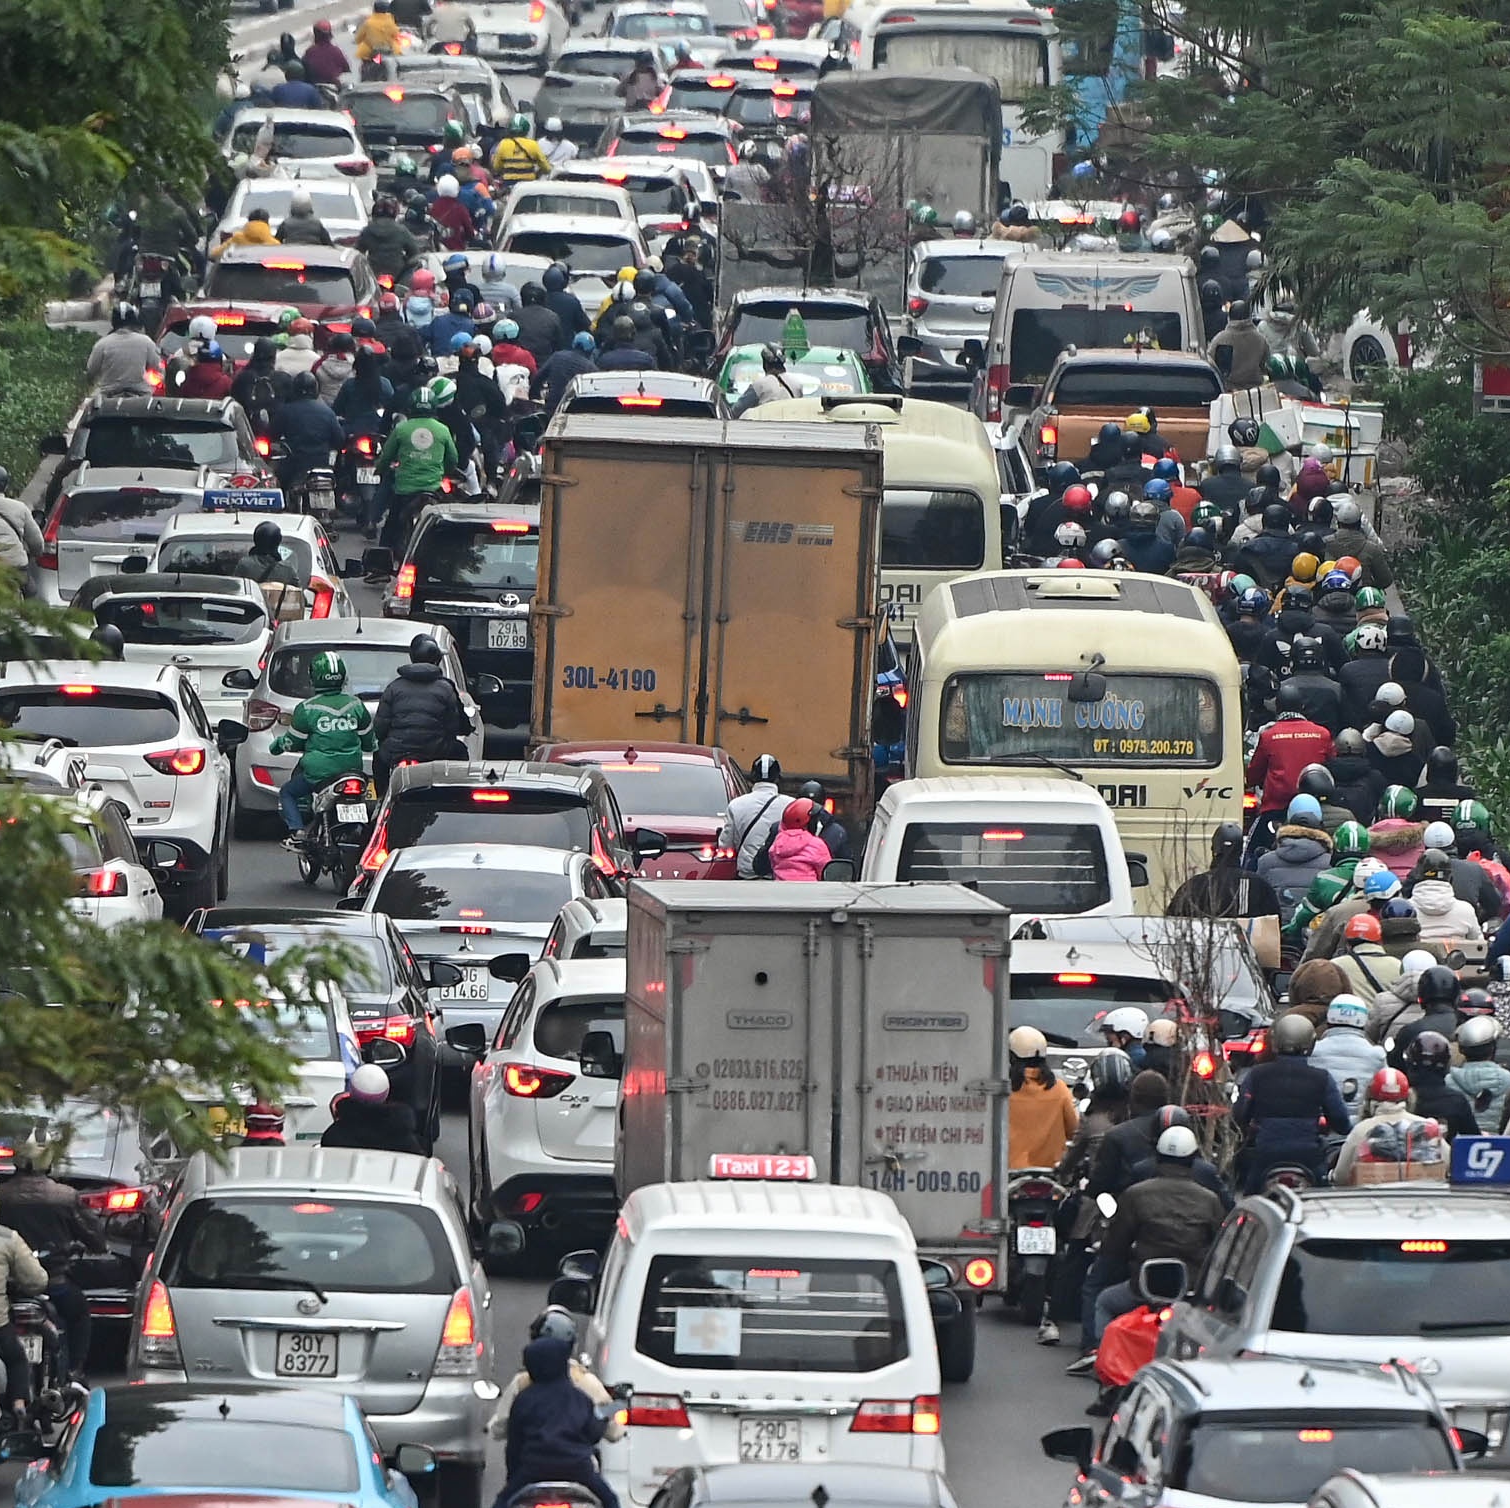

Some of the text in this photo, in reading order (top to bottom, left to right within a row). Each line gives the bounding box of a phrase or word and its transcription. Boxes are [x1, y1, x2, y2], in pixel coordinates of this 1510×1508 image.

[743, 521, 795, 544] EMS
[497, 622, 519, 635] 29A
[491, 635, 526, 648] 107.89
[324, 672, 343, 682] Grab
[562, 665, 656, 692] 30L-4190
[316, 713, 359, 733] Grab
[1002, 698, 1063, 733] MẠNH
[1119, 739, 1195, 755] 0975.200.378
[1183, 777, 1234, 800] VTC
[442, 983, 488, 999] 314.66
[732, 1015, 788, 1025] THACO
[886, 1016, 963, 1027] FRONTIER
[886, 1060, 959, 1086] THUẬN TIỆN
[885, 1090, 988, 1113] GIAO HÀNG NHANH
[885, 1119, 985, 1146] TIẾT KIỆM CHI PHÍ
[717, 1158, 808, 1177] Taxi 123
[1468, 1142, 1505, 1178] G7
[870, 1169, 982, 1193] 14H-009.60
[290, 1334, 325, 1353] 30Y
[283, 1354, 330, 1373] 8377
[754, 1422, 788, 1441] 29D
